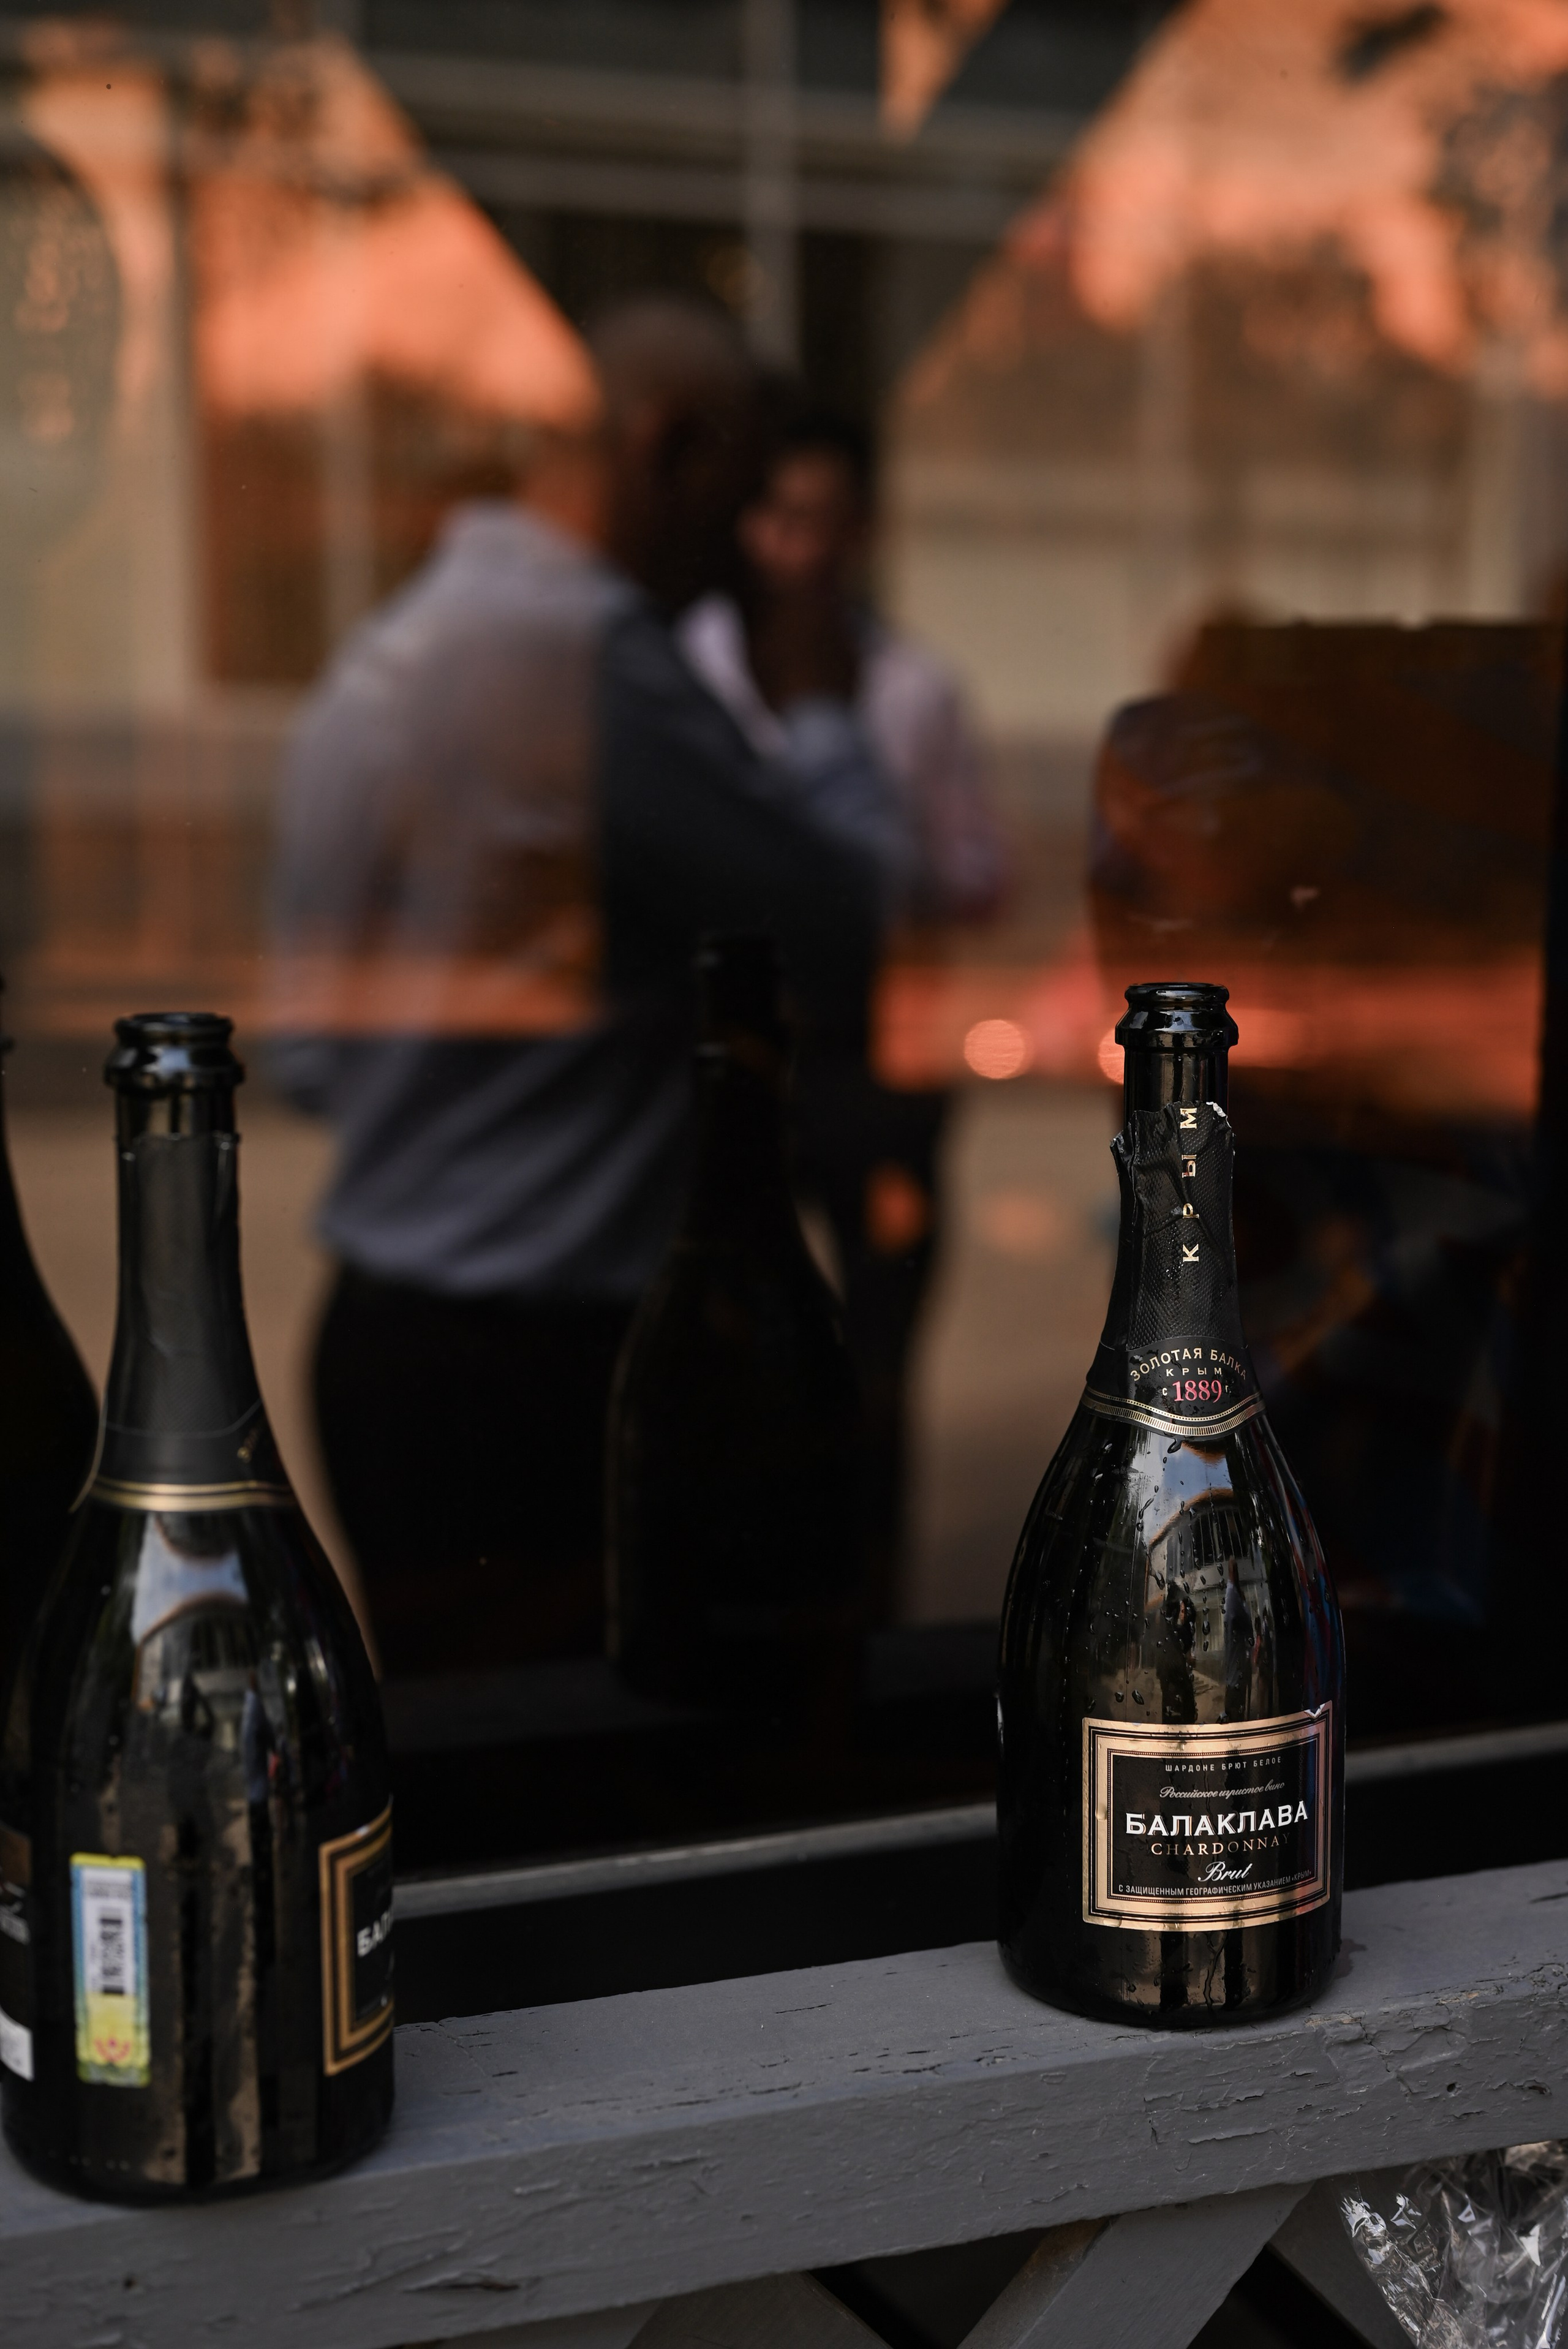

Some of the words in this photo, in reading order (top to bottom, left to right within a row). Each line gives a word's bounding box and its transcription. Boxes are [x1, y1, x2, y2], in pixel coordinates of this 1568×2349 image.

[1180, 1107, 1200, 1262] КРЫМ
[1130, 1348, 1202, 1382] ЗОЛОТАЯ
[1210, 1349, 1247, 1381] БАЛКА
[1166, 1367, 1223, 1377] КРЫМ
[1172, 1379, 1222, 1403] 1889
[1165, 1764, 1215, 1773] ШАРДОНЕ
[1221, 1761, 1247, 1771] БРЮТ
[1253, 1756, 1282, 1767] БЕЛОЕ
[1159, 1786, 1218, 1798] Российское
[1219, 1785, 1264, 1800] игристое
[1264, 1779, 1285, 1792] вино
[1125, 1800, 1308, 1837] БАЛАКЛАВА
[1150, 1833, 1291, 1856] CHARDONNAY
[1126, 1885, 1184, 1896] ЗАЩИЩЕННЫМ
[1186, 1883, 1253, 1896] ГЕОГРАФИЧЕСКИМ
[1253, 1877, 1291, 1890] УКАЗАНИЕМ
[1291, 1869, 1312, 1881] «КРЫМ»
[1197, 1861, 1253, 1882] Brut
